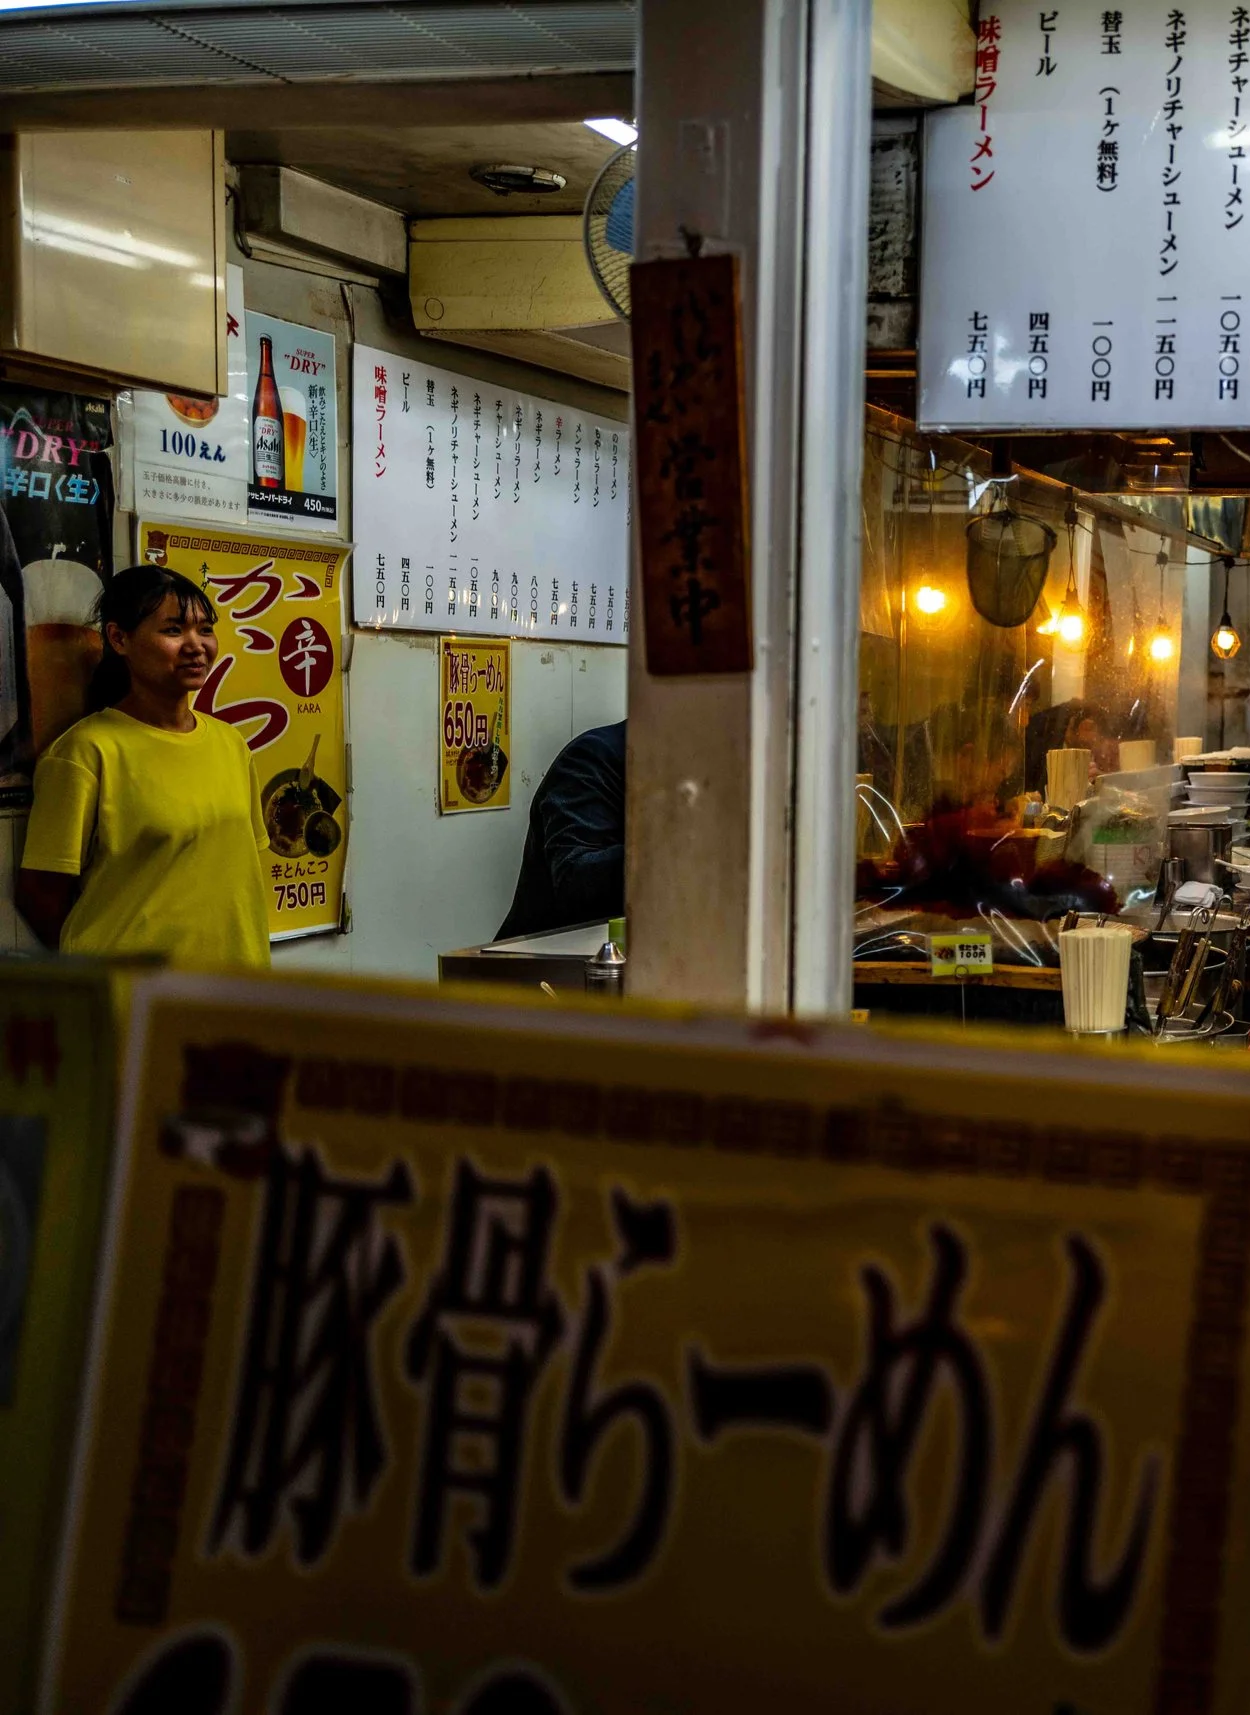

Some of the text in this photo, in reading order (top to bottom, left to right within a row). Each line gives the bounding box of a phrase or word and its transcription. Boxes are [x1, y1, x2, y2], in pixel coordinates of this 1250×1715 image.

[1036, 10, 1059, 77] ビール
[1101, 11, 1122, 55] 替玉
[970, 15, 1001, 192] 味噌ラーメン
[1224, 6, 1250, 231] ネギチャーシューメン
[1160, 9, 1187, 277] ネギノリチャーシューメン
[296, 347, 316, 360] SUPER
[85, 402, 105, 414] Asahi
[401, 372, 411, 414] ビール
[426, 379, 436, 407] 替玉
[159, 428, 227, 464] 100えん
[257, 435, 281, 454] Asahi
[374, 366, 388, 479] 味噌ラーメン
[494, 400, 504, 501] チャーシューメン
[533, 411, 543, 484] ネギラーメン
[450, 385, 459, 544] ネギノリチャーシューメン
[472, 392, 482, 521] ネギチャーシューメン
[513, 405, 523, 505] ネギノリラーメン
[282, 620, 328, 697] 辛
[448, 652, 504, 694] 豚骨らーめん
[297, 702, 322, 715] KARA
[444, 700, 489, 749] 650円
[271, 860, 330, 881] 辛とんこつ
[274, 881, 327, 912] 750円
[203, 1140, 1165, 1658] 豚骨らーめん
